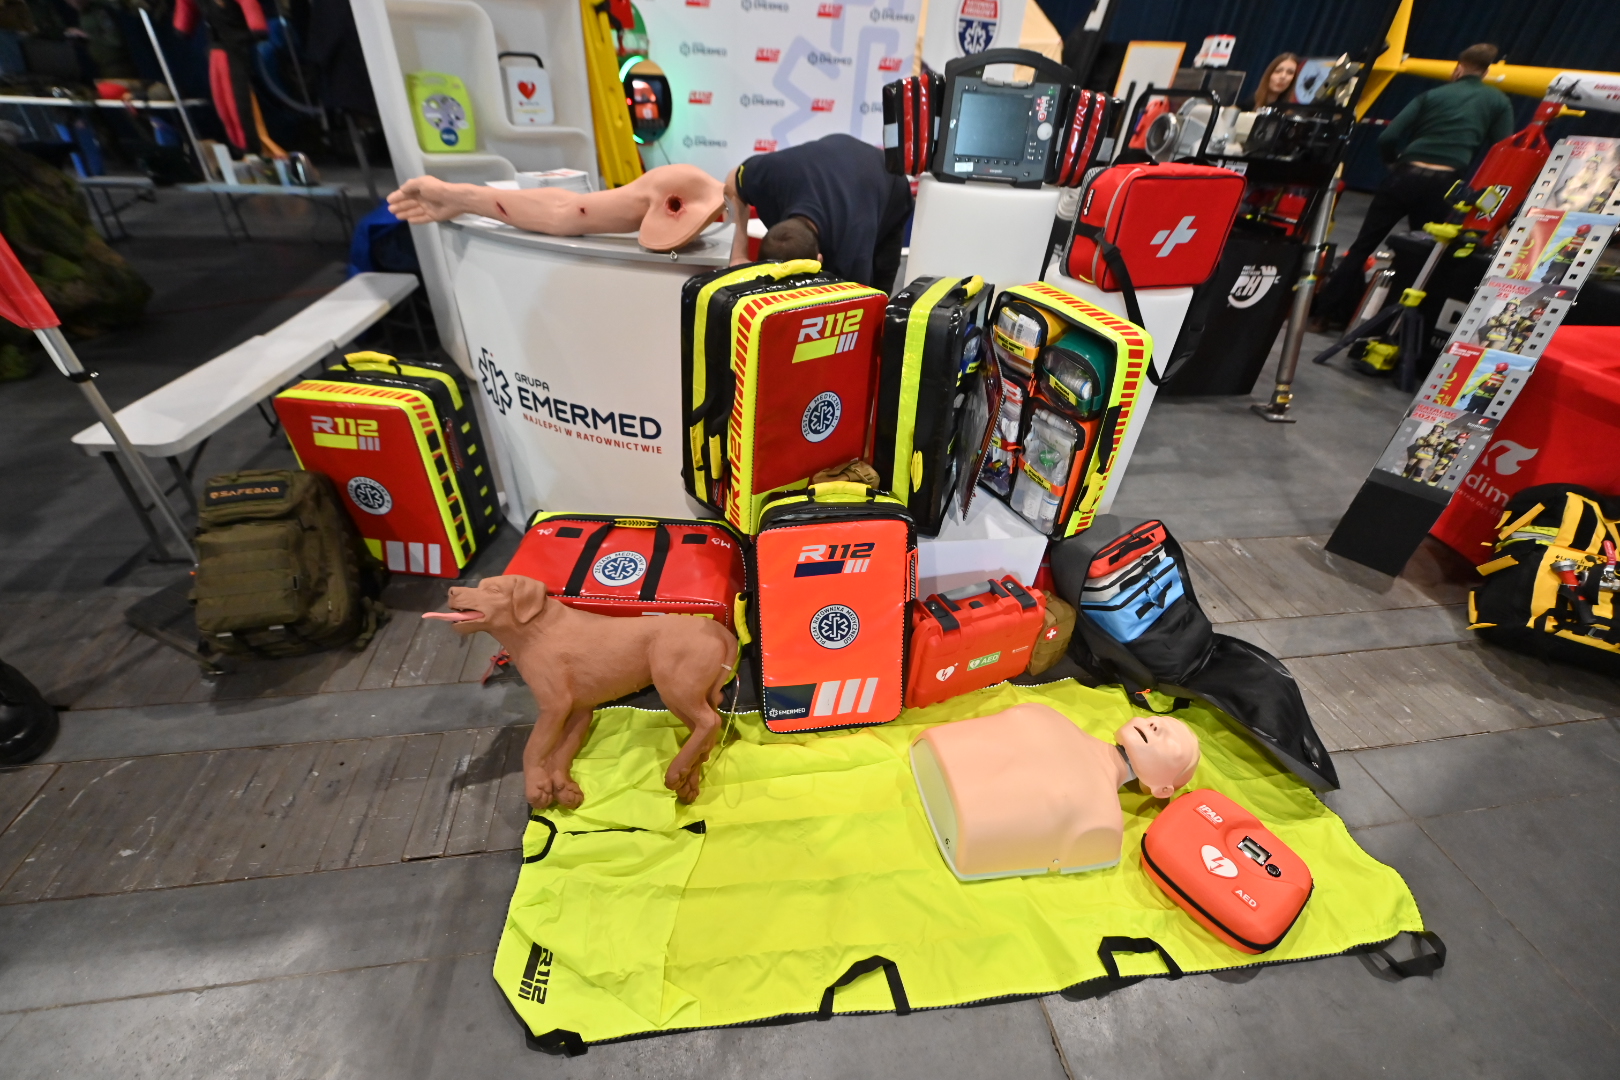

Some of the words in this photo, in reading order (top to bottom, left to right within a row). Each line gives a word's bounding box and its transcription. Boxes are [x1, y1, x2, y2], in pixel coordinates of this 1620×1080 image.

[798, 308, 864, 342] R112
[514, 372, 550, 392] GRUPA
[814, 394, 840, 410] MEDYCZNY
[1416, 404, 1458, 418] KATALOG
[517, 386, 662, 440] EMERMED
[311, 416, 379, 436] R112
[523, 413, 562, 434] NAJLEPSI
[565, 428, 573, 436] W
[576, 432, 662, 454] RATOWNICTWIE
[220, 486, 280, 498] SAFEBAG
[798, 542, 876, 562] R112
[595, 556, 612, 574] ZESTAW
[615, 552, 644, 566] MEDYCZNY
[813, 606, 844, 624] RATOWNIKA
[844, 610, 858, 644] MEDYCZNEGO
[981, 654, 999, 664] AED
[778, 708, 806, 716] EMERMED
[1235, 889, 1257, 907] AED
[531, 948, 554, 1004] R112
